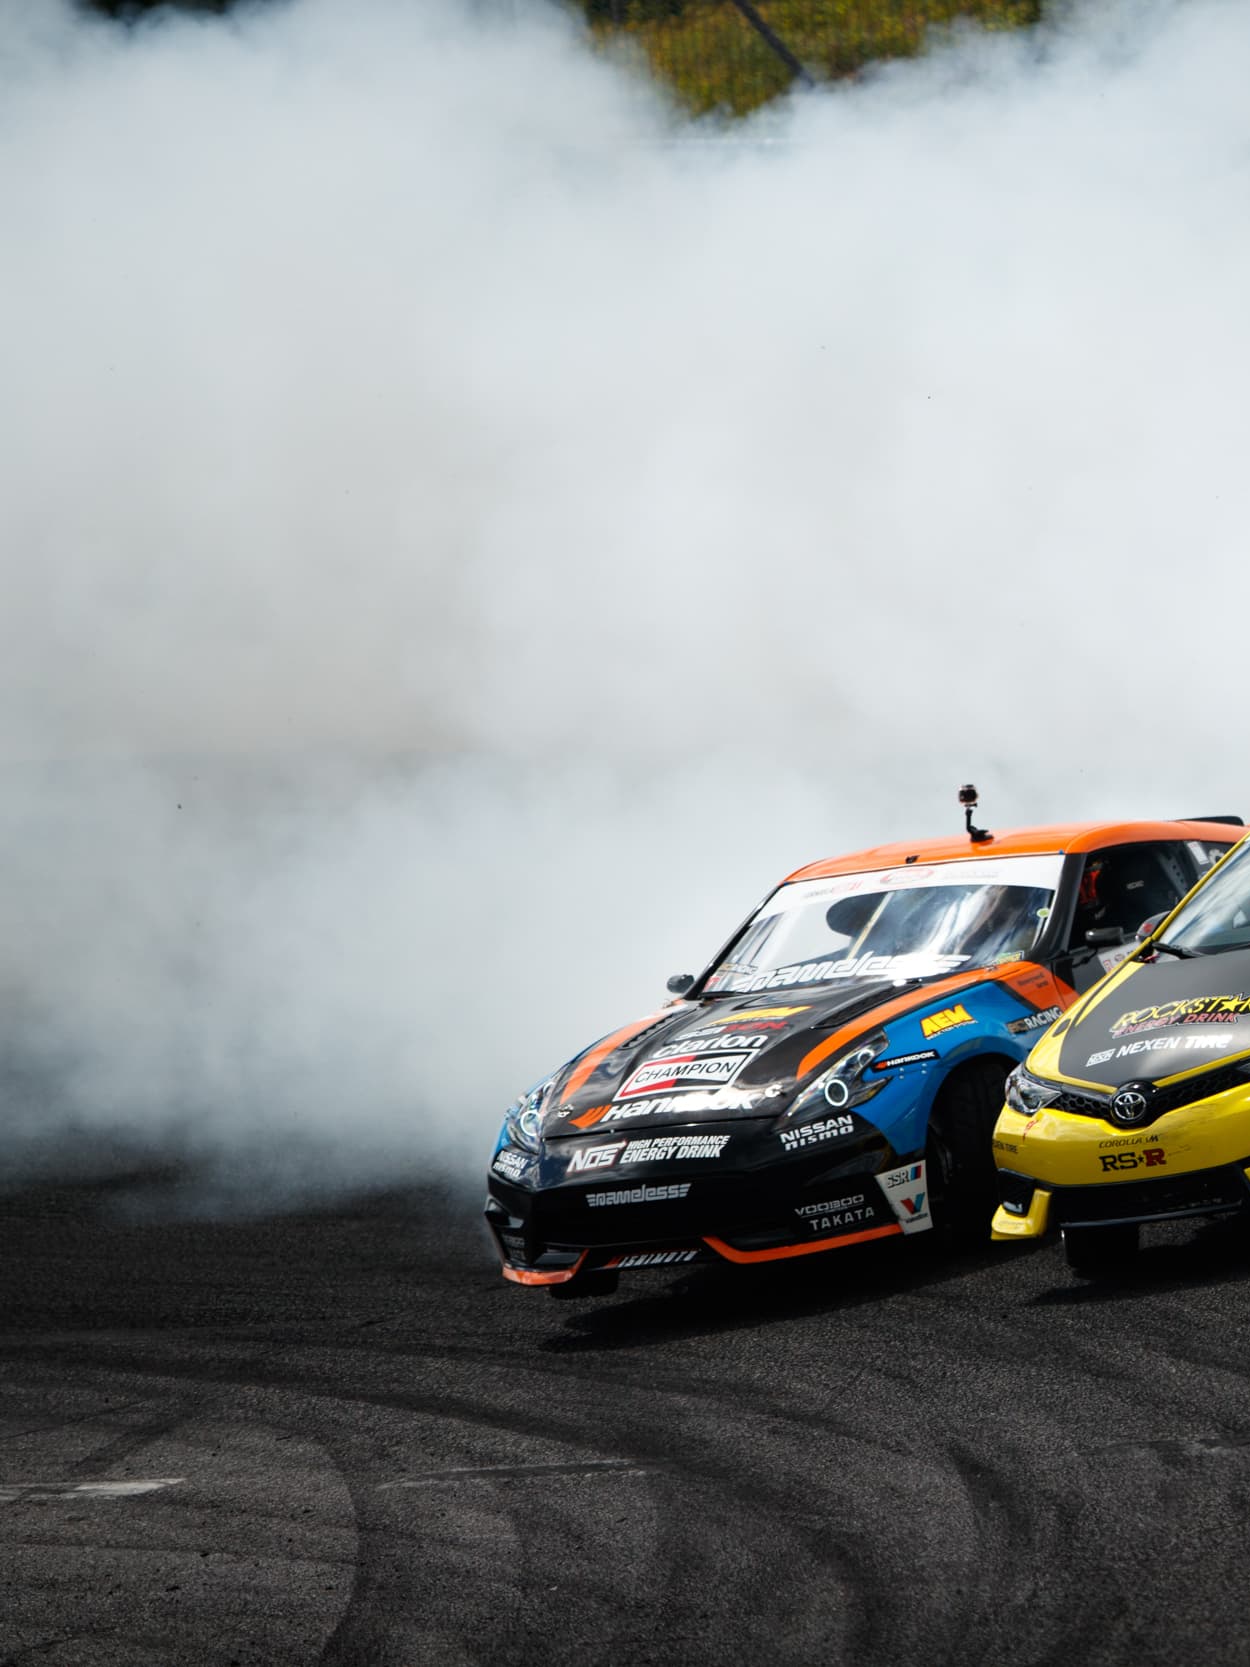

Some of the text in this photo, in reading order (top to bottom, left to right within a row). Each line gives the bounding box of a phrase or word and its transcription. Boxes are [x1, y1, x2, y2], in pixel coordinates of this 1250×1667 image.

[920, 1003, 975, 1038] AEM
[1025, 1007, 1063, 1031] RACING
[1183, 1012, 1239, 1024] DRINK
[652, 1033, 768, 1059] Clarion
[1116, 1037, 1183, 1058] NEXEN
[634, 1060, 737, 1084] CHAMPION
[780, 1115, 853, 1143] NISSAN
[785, 1125, 854, 1151] nismo
[620, 1144, 725, 1164] ENERGY DRINK
[626, 1135, 731, 1151] HIGH PERFORMANCE
[1099, 1137, 1142, 1149] COROLLA
[497, 1150, 528, 1169] NISSAN
[566, 1141, 627, 1173] NOS
[588, 1184, 689, 1206] nameless
[810, 1207, 875, 1231] TAKATA
